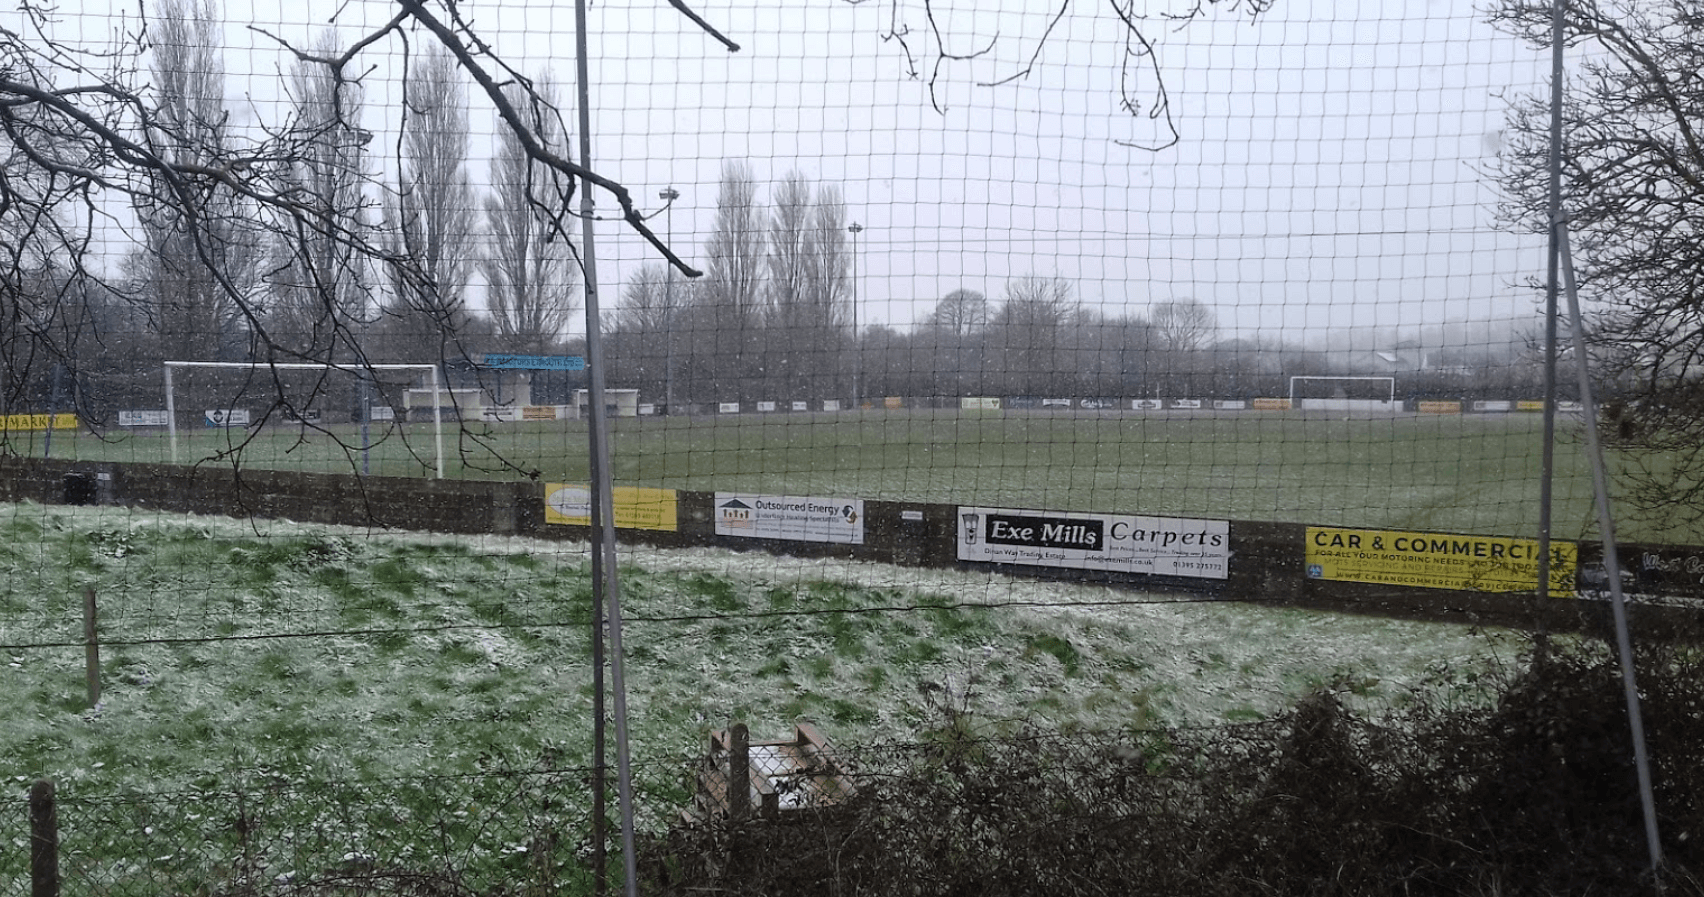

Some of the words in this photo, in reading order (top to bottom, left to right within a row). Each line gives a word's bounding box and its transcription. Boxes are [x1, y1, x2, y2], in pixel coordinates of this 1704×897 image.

[755, 500, 806, 512] Outsourced
[809, 503, 840, 516] Energy
[991, 520, 1034, 541] Exe
[1040, 523, 1097, 545] Mills
[1110, 521, 1222, 547] Carpets
[1004, 549, 1018, 558] Way
[1020, 550, 1042, 559] Trading
[1314, 531, 1361, 549] CAR
[1371, 536, 1384, 551] &
[1394, 537, 1561, 564] COMMERCIL
[1173, 561, 1194, 569] 01395
[1335, 550, 1351, 558] ALL
[1354, 551, 1379, 560] YOUR
[1381, 553, 1431, 564] MOTORING
[1433, 556, 1465, 566] NEEDS
